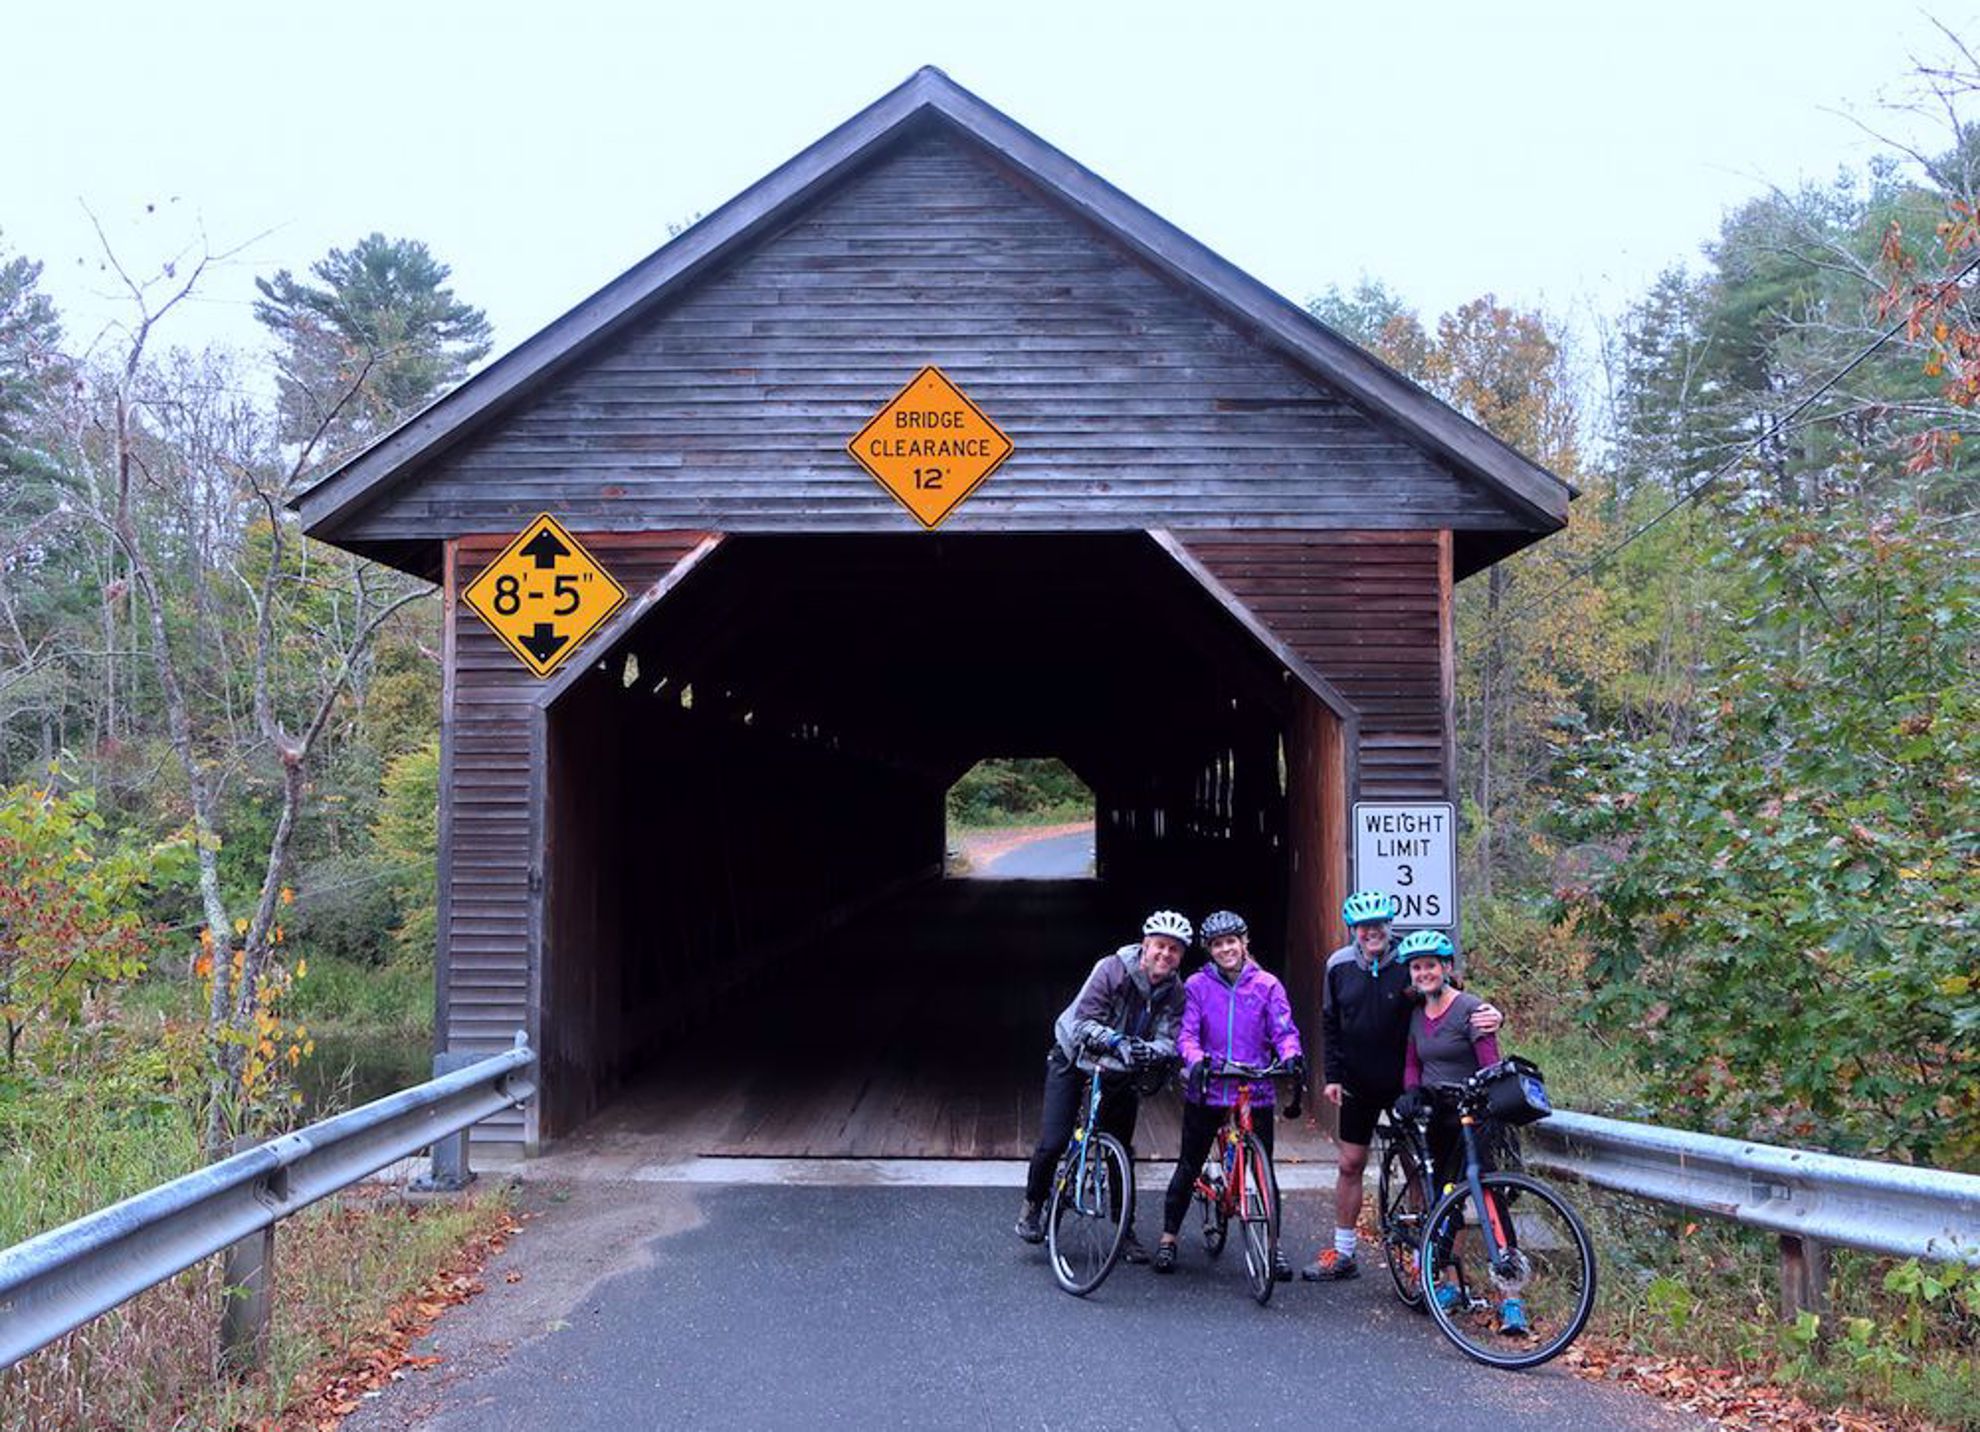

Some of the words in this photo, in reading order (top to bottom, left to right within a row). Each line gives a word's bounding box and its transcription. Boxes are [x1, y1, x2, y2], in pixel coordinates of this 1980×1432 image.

[896, 411, 964, 428] BRIDGE
[870, 439, 990, 456] CLEARANCE
[1365, 815, 1443, 833] WEIGHT
[1377, 839, 1431, 856] LIMIT
[1397, 865, 1413, 886] 3
[1389, 894, 1440, 917] ONS
